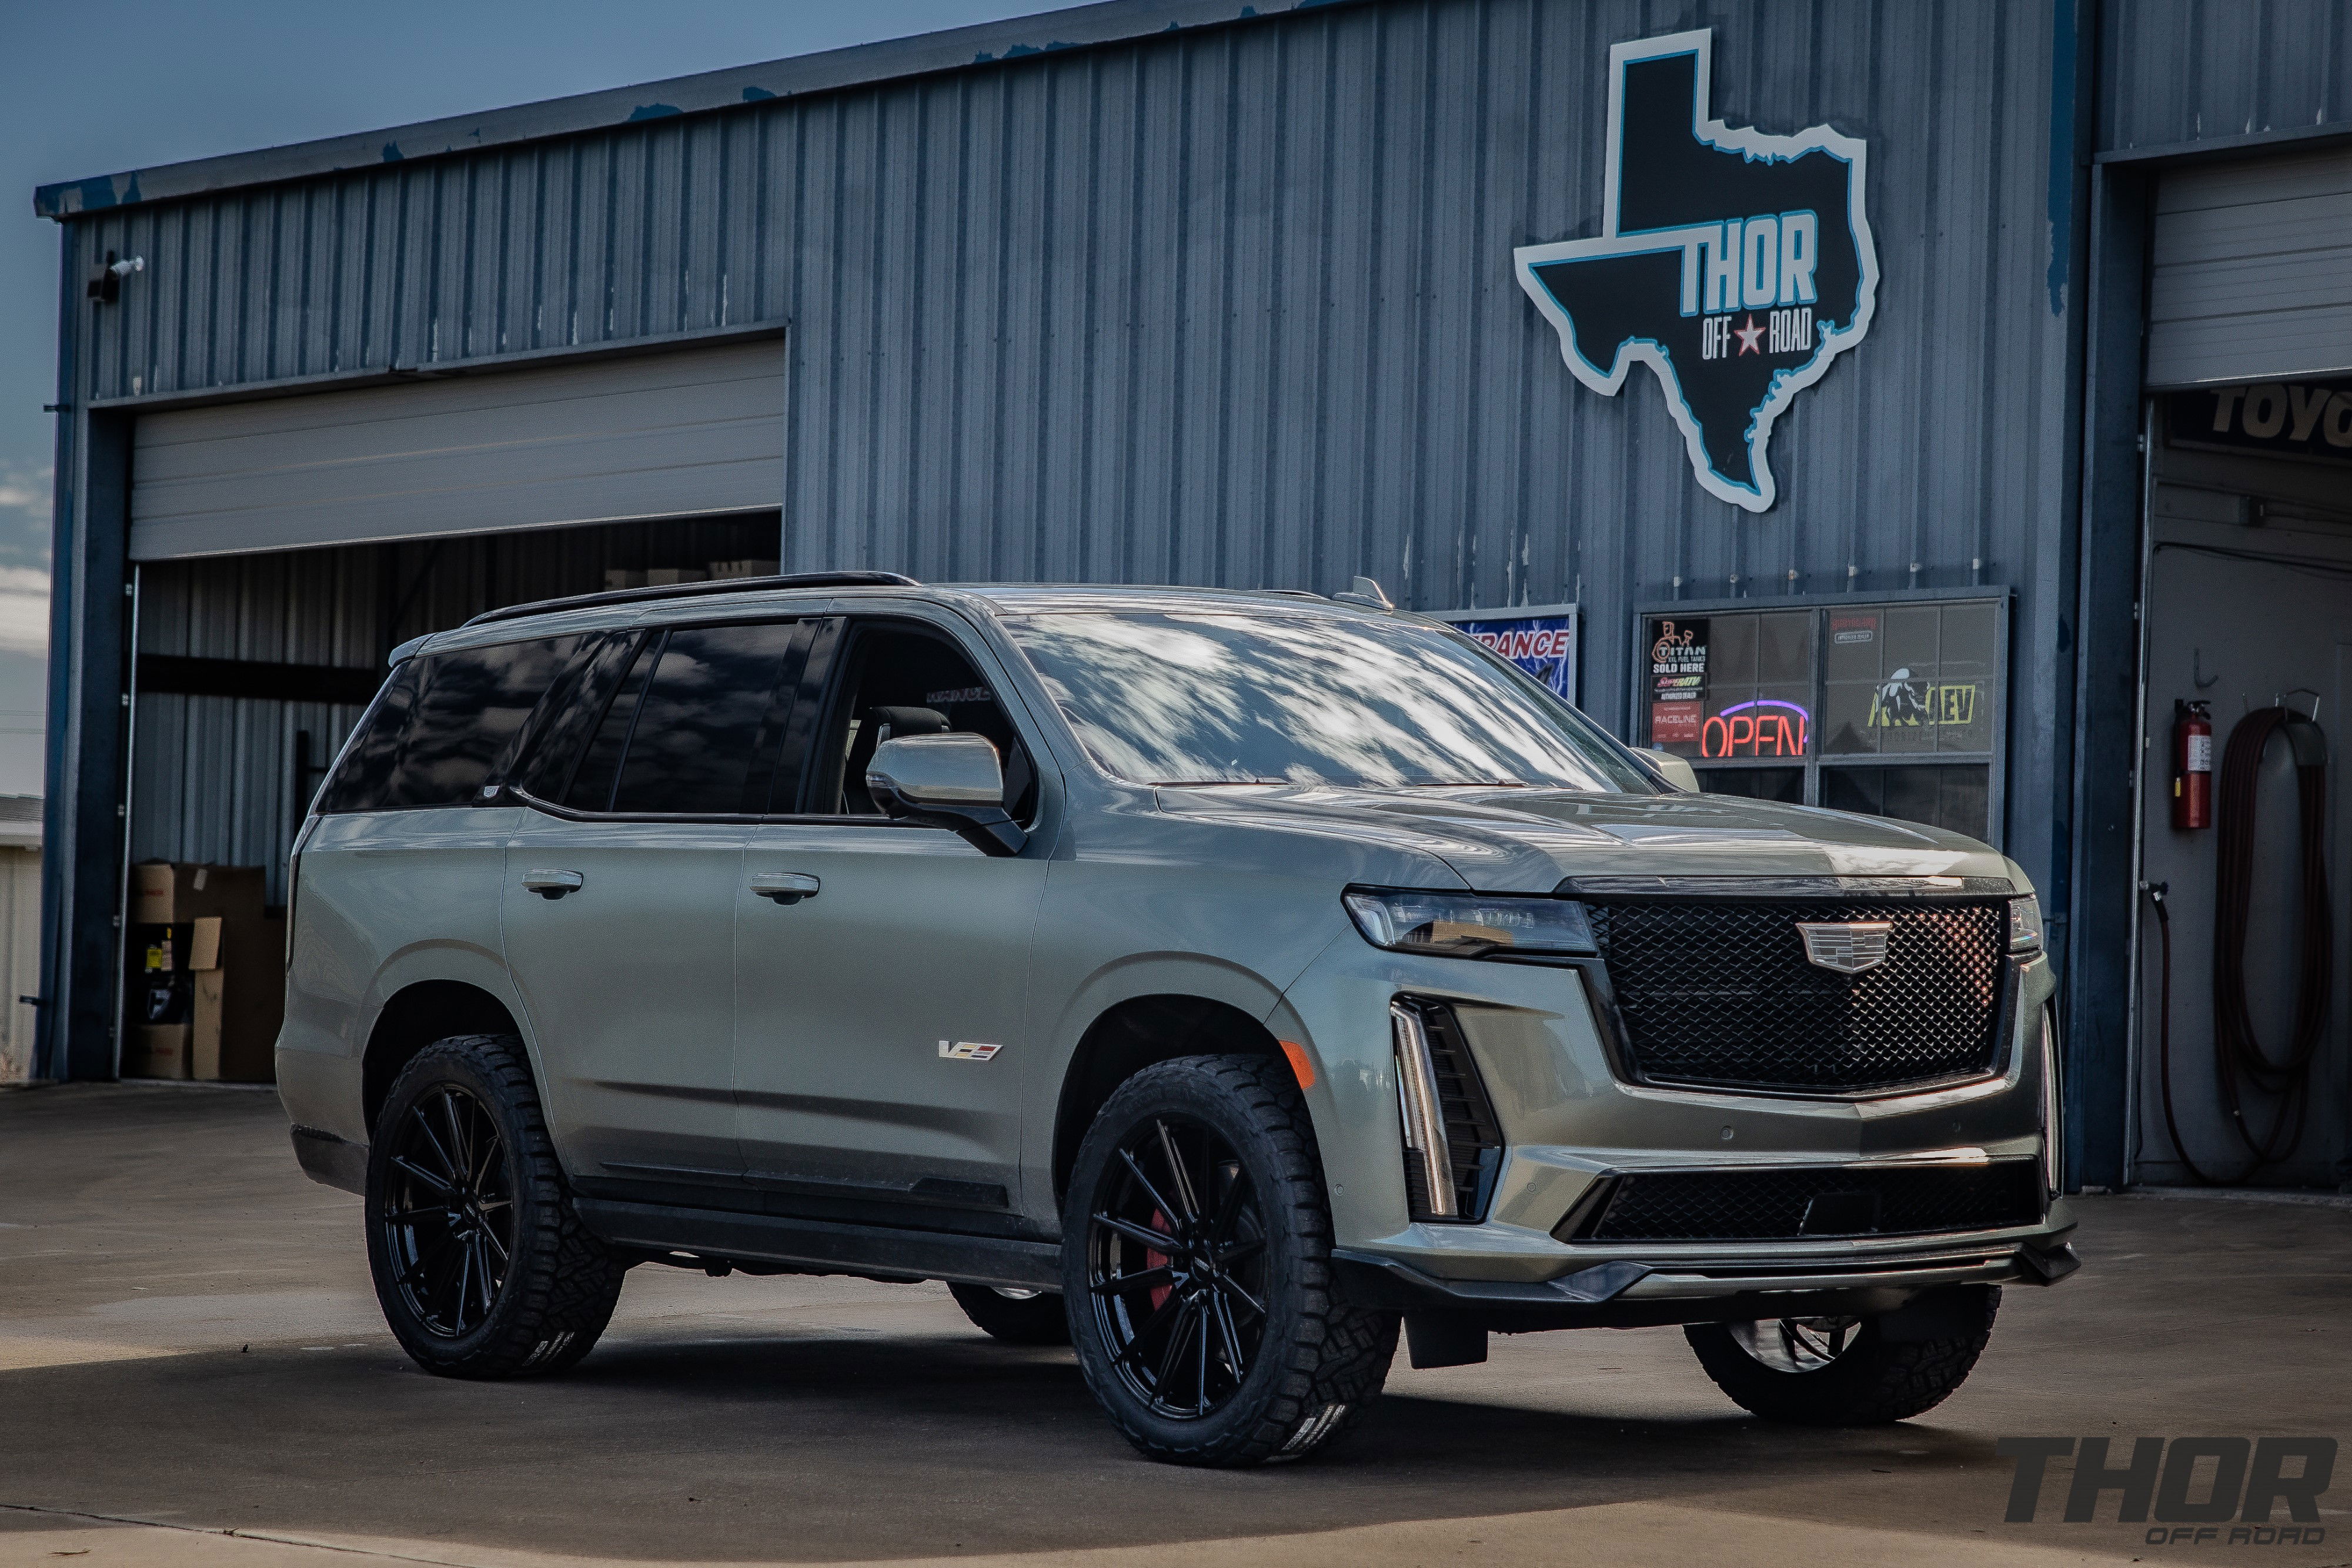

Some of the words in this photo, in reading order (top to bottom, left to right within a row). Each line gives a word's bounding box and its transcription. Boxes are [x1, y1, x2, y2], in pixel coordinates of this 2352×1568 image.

[1678, 210, 1818, 317] THOR
[1702, 315, 1732, 360] OFF
[1769, 307, 1812, 353] ROAD
[1473, 629, 1570, 659] RANCE
[1659, 646, 1706, 656] TITAN
[1653, 664, 1678, 673] SOLD
[1680, 663, 1705, 673] HERE
[1702, 716, 1805, 757] OPEN
